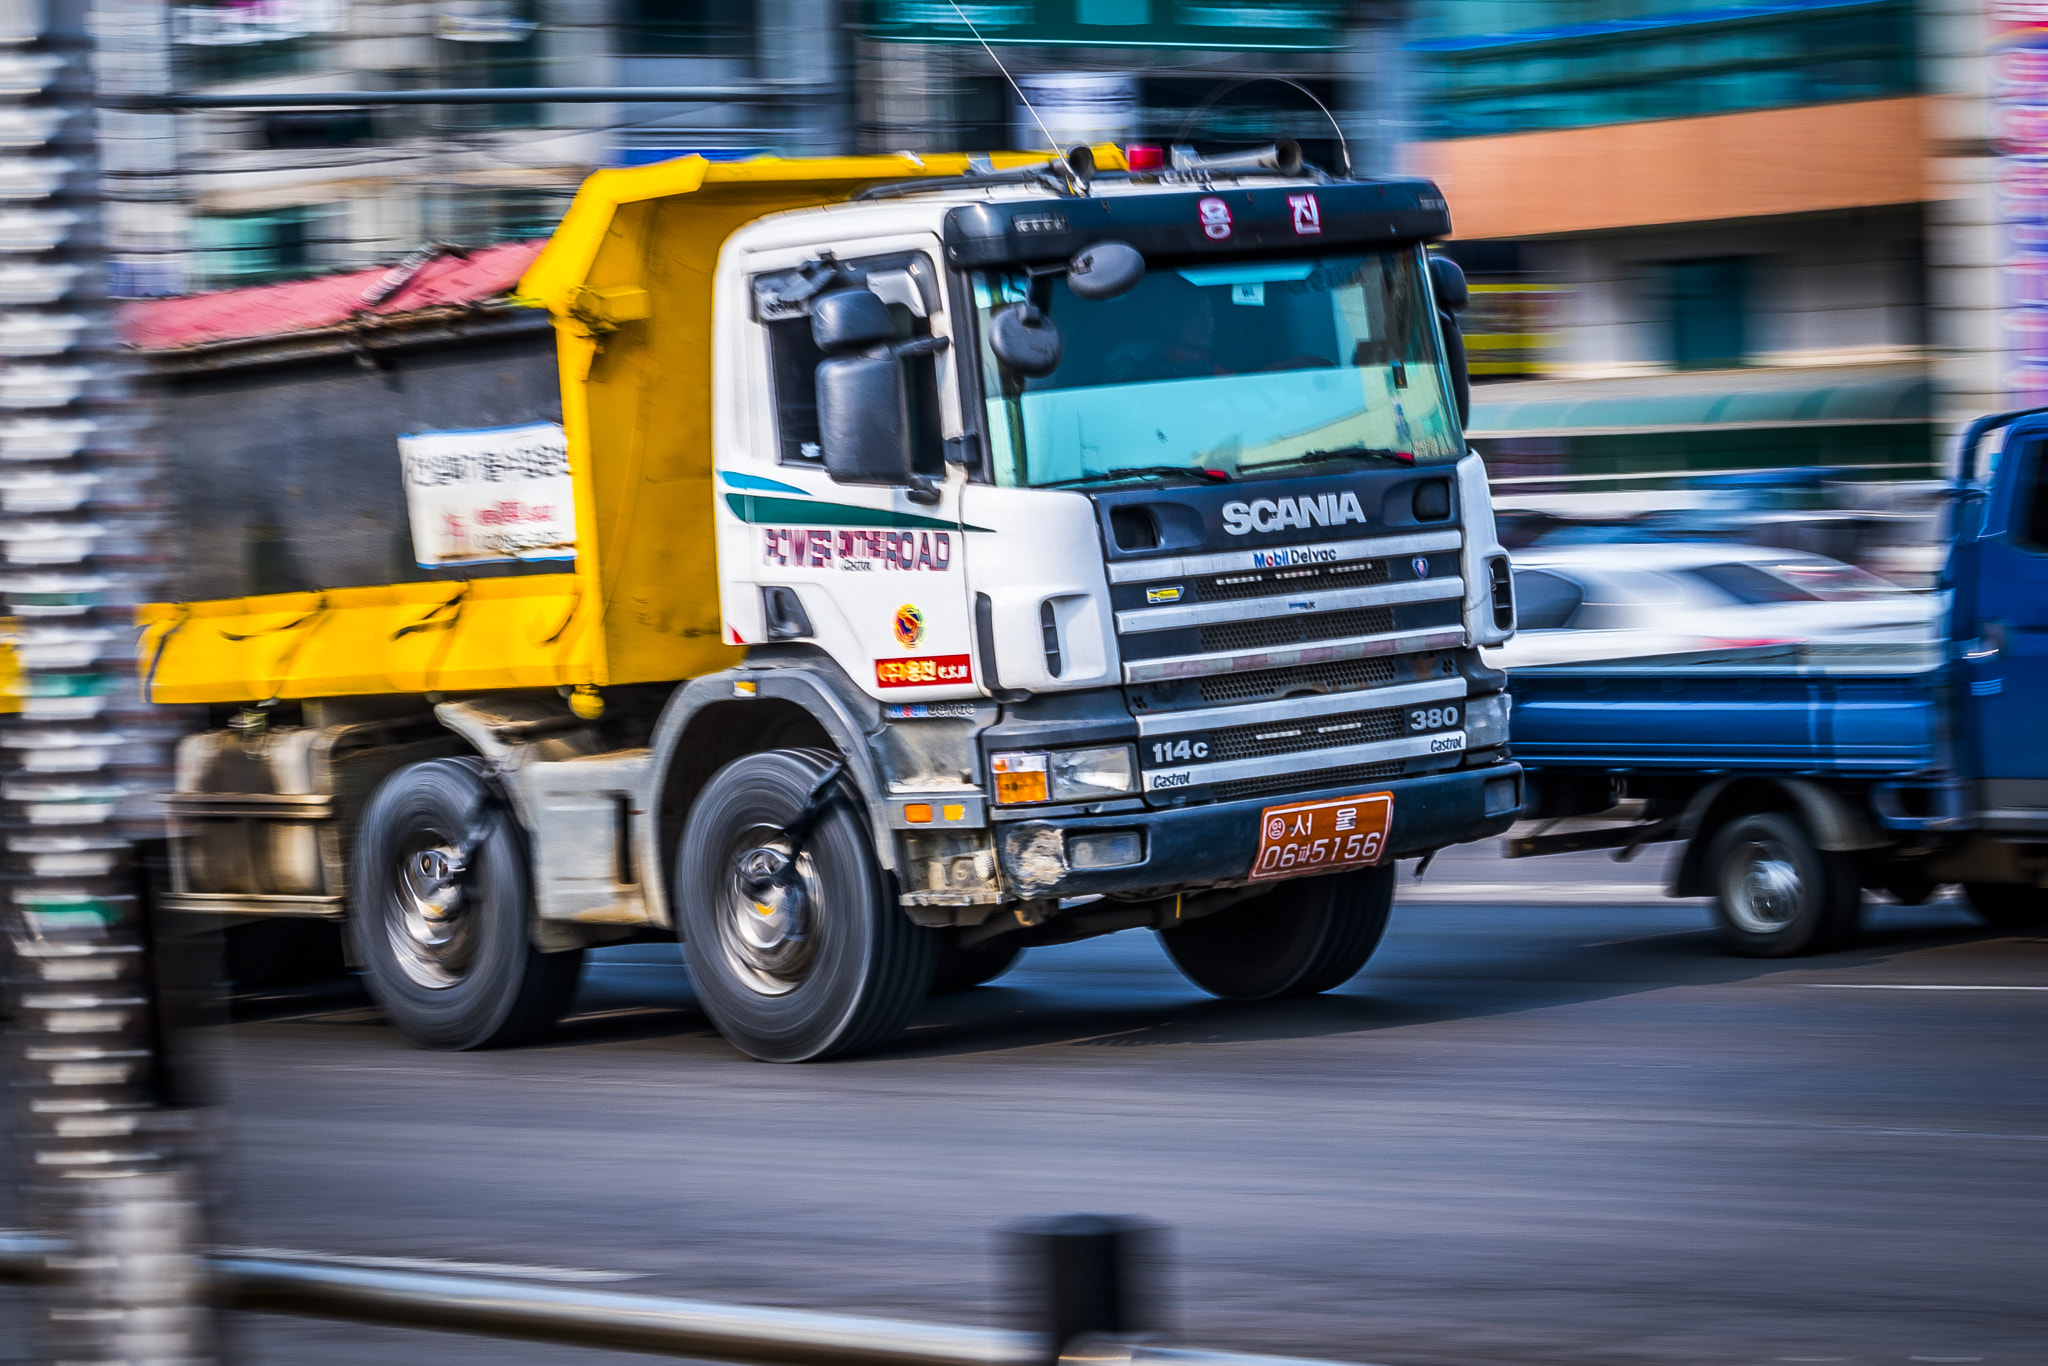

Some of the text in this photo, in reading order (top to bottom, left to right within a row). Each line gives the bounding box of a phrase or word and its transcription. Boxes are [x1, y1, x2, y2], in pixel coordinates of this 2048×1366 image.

[1222, 490, 1366, 535] SCANIA
[1253, 547, 1337, 568] Mobil Delvac
[1410, 706, 1458, 730] 380
[1430, 735, 1463, 753] Castrol
[1153, 771, 1191, 788] Castrol
